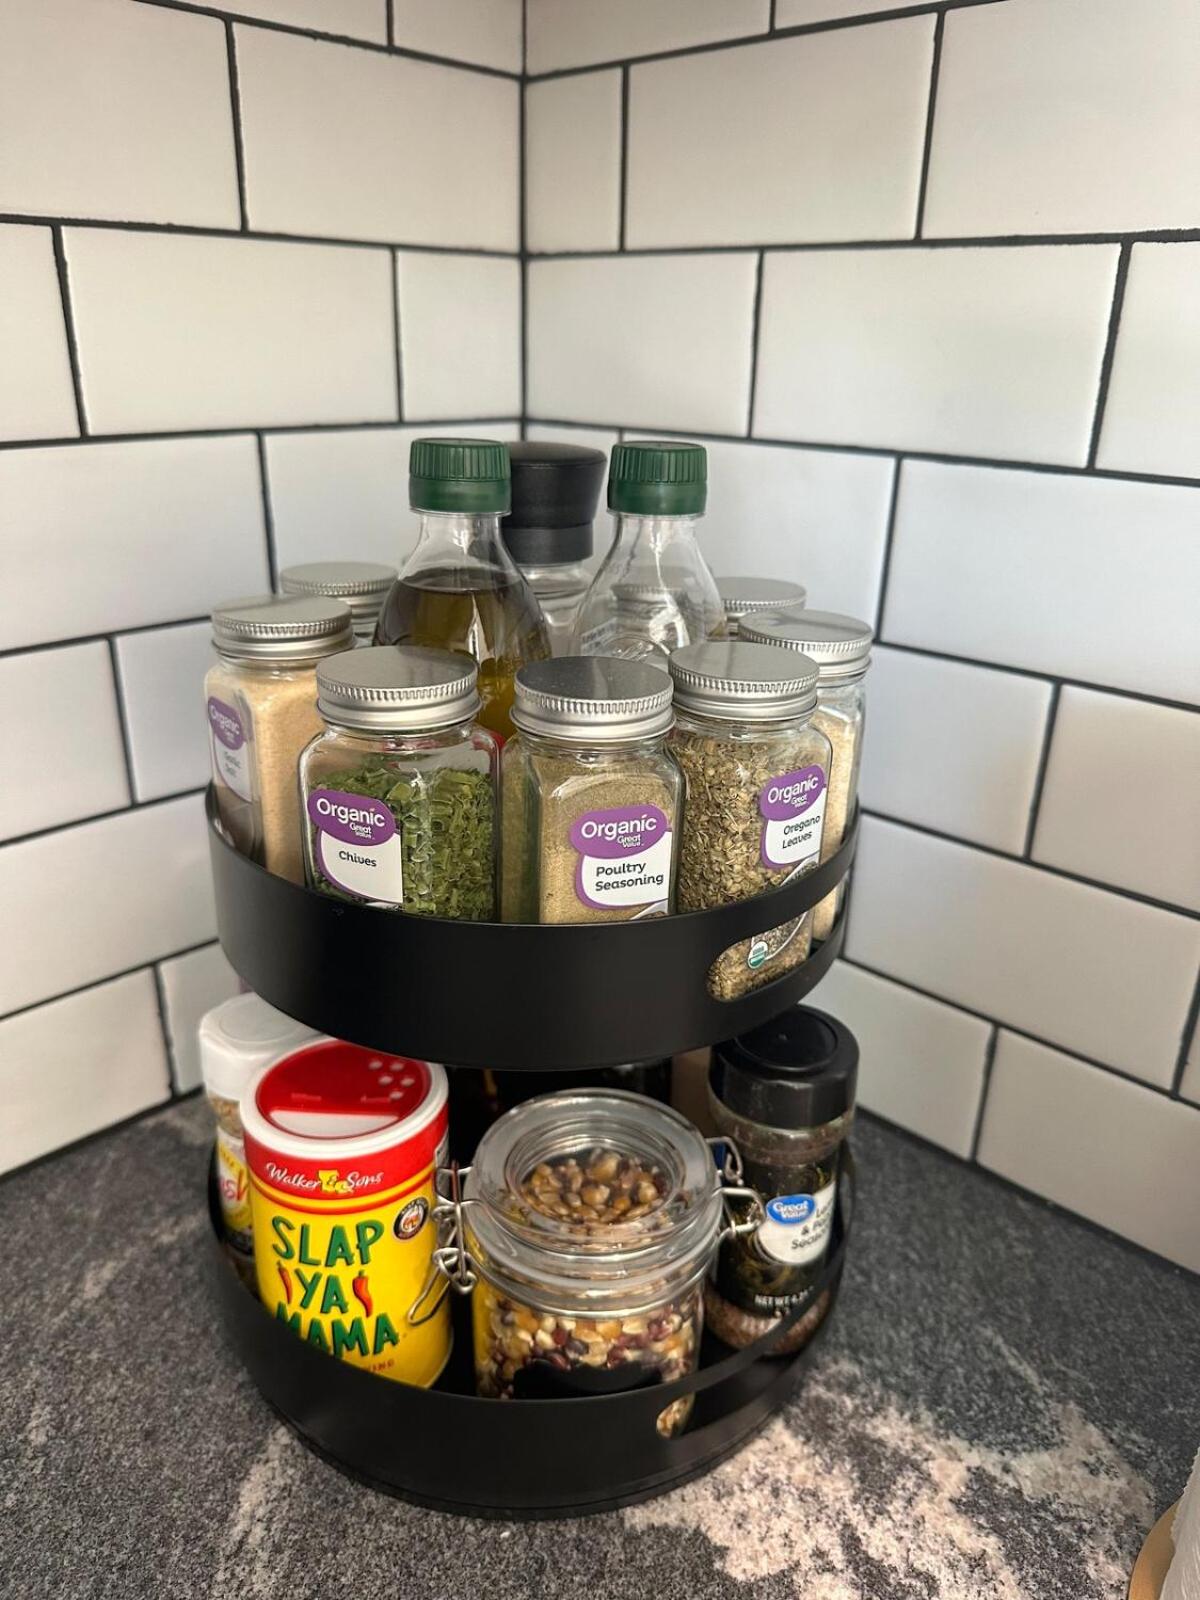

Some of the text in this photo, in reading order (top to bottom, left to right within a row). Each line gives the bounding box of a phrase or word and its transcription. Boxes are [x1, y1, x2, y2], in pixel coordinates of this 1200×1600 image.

[767, 774, 819, 804] Organic
[316, 797, 386, 827] Organic
[783, 815, 821, 836] Oregano
[581, 814, 658, 841] Organic
[782, 831, 812, 849] Leaves
[338, 850, 377, 867] Chives
[595, 862, 647, 877] Poultry
[594, 873, 665, 892] Seasoning
[265, 1162, 321, 1192] Walker
[345, 1171, 385, 1193] Sons
[271, 1215, 385, 1268] SLAP
[294, 1268, 350, 1315] YA
